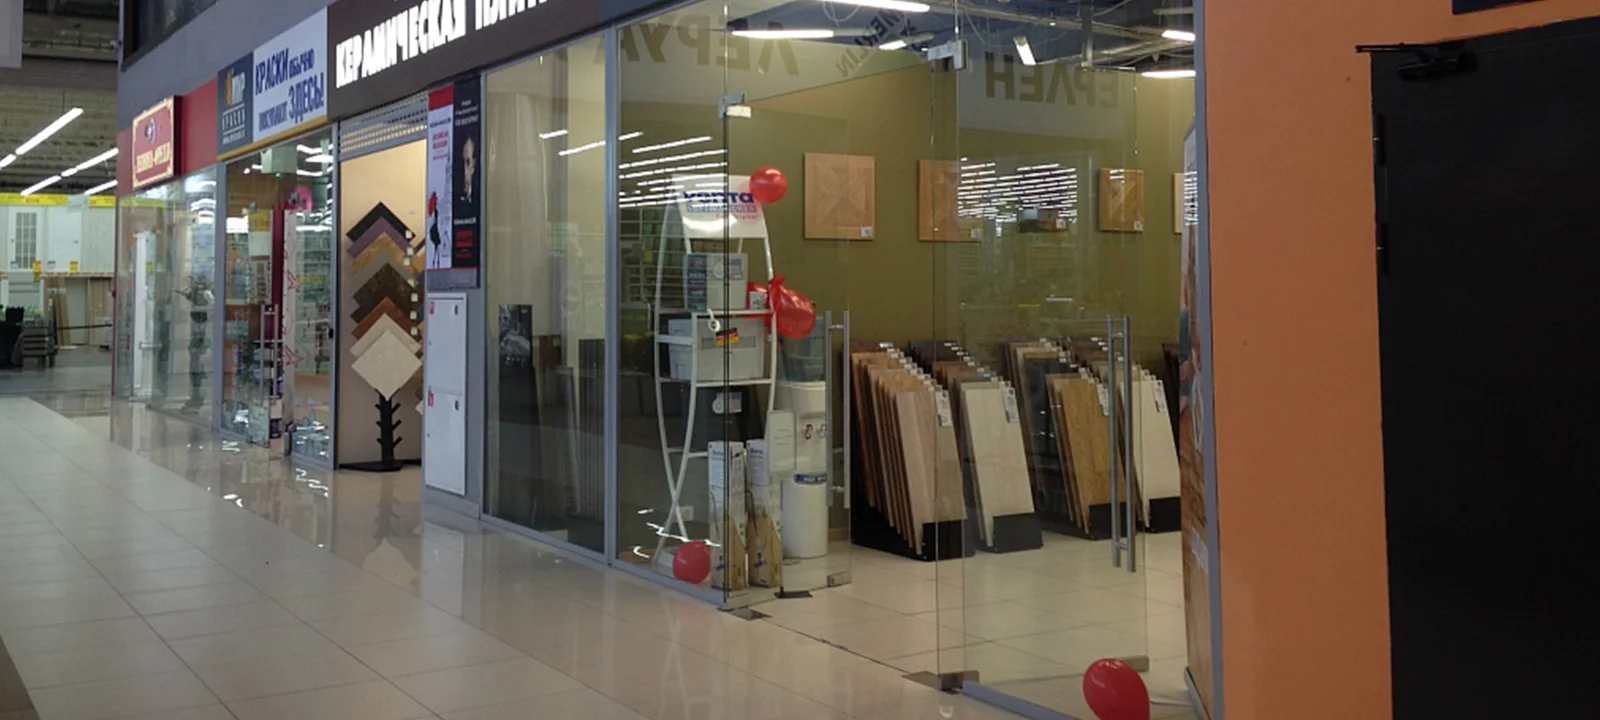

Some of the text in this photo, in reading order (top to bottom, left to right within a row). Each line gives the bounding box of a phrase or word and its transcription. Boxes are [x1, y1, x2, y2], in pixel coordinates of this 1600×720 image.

[336, 0, 466, 88] КЕРАМИЧЕСКАЯ
[255, 47, 289, 95] КРАСКИ
[289, 72, 324, 124] ЗДЕСЬ!
